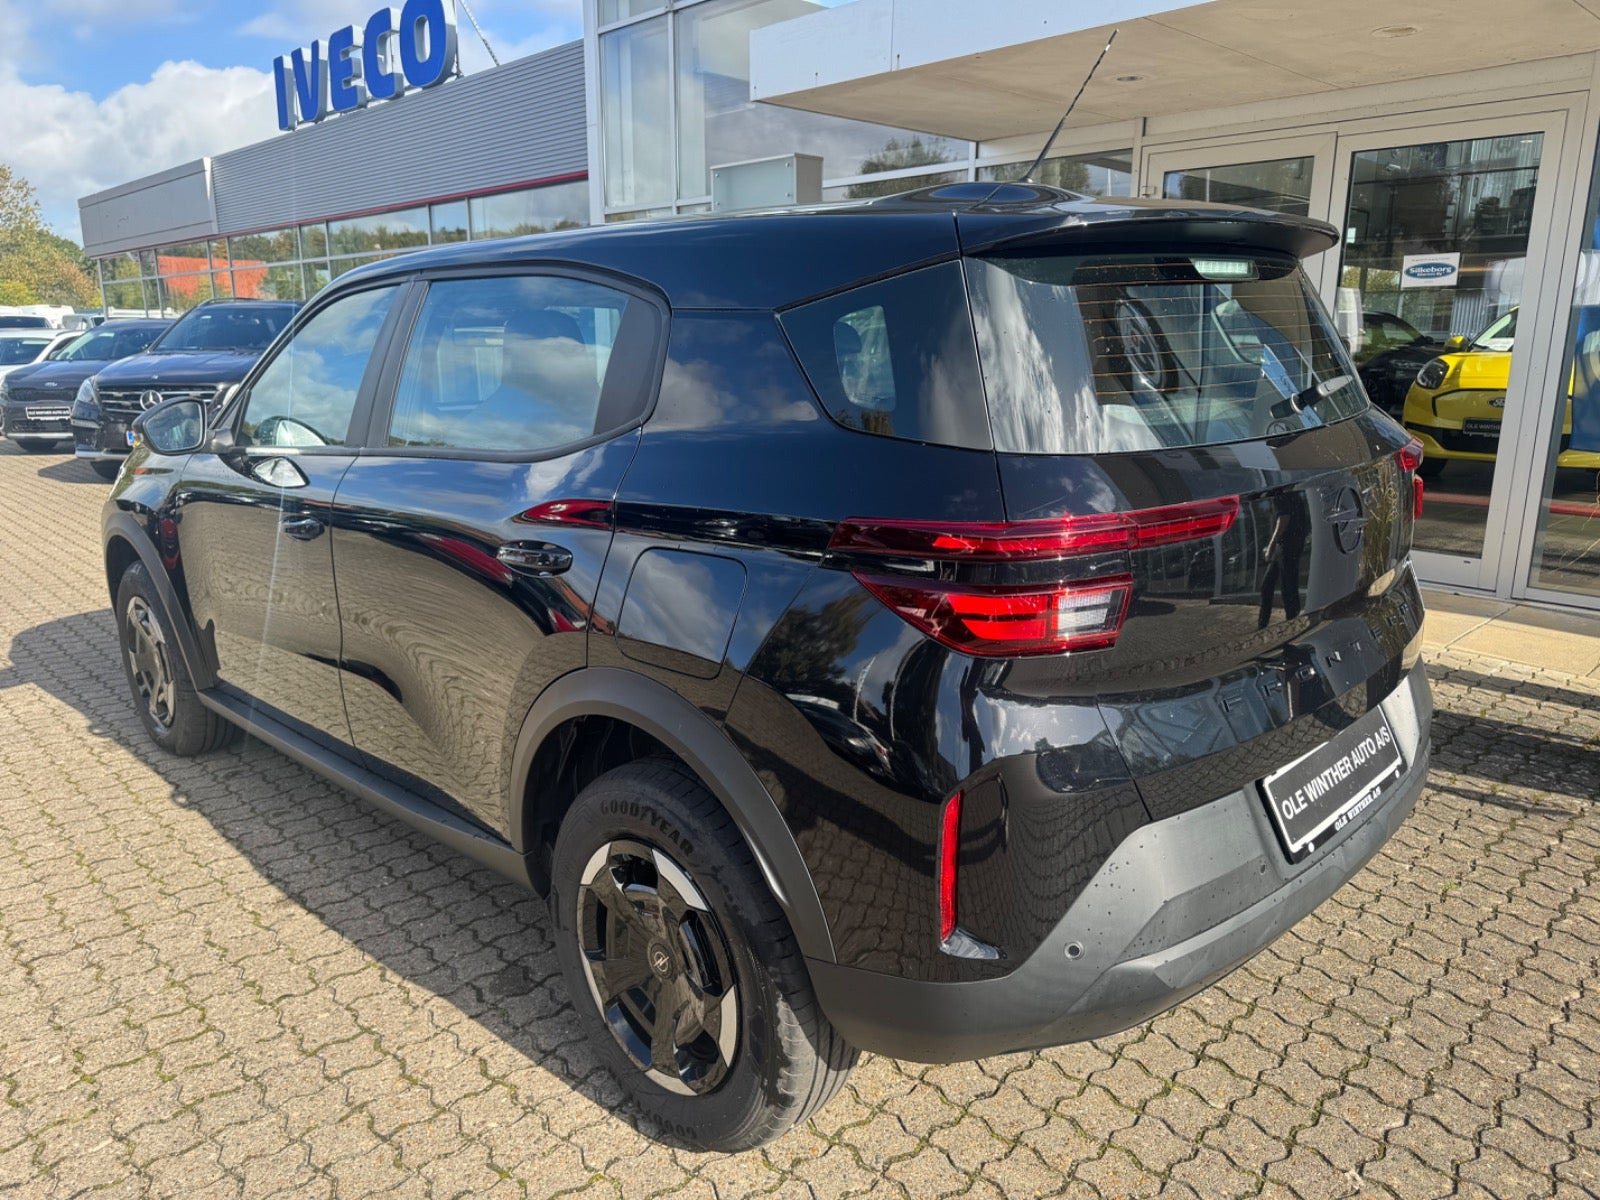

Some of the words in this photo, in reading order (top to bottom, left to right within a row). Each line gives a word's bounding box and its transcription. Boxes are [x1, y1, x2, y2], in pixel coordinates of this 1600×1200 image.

[273, 0, 451, 131] IVECO
[1409, 266, 1452, 274] Silkeborg
[1282, 789, 1308, 820] OLE
[1304, 757, 1353, 802] WINTHER
[1351, 737, 1377, 769] AUTO
[1375, 725, 1391, 751] A/S
[600, 799, 694, 857] GOODYEAR
[1334, 814, 1348, 831] OLE
[1347, 793, 1374, 820] WINTHER
